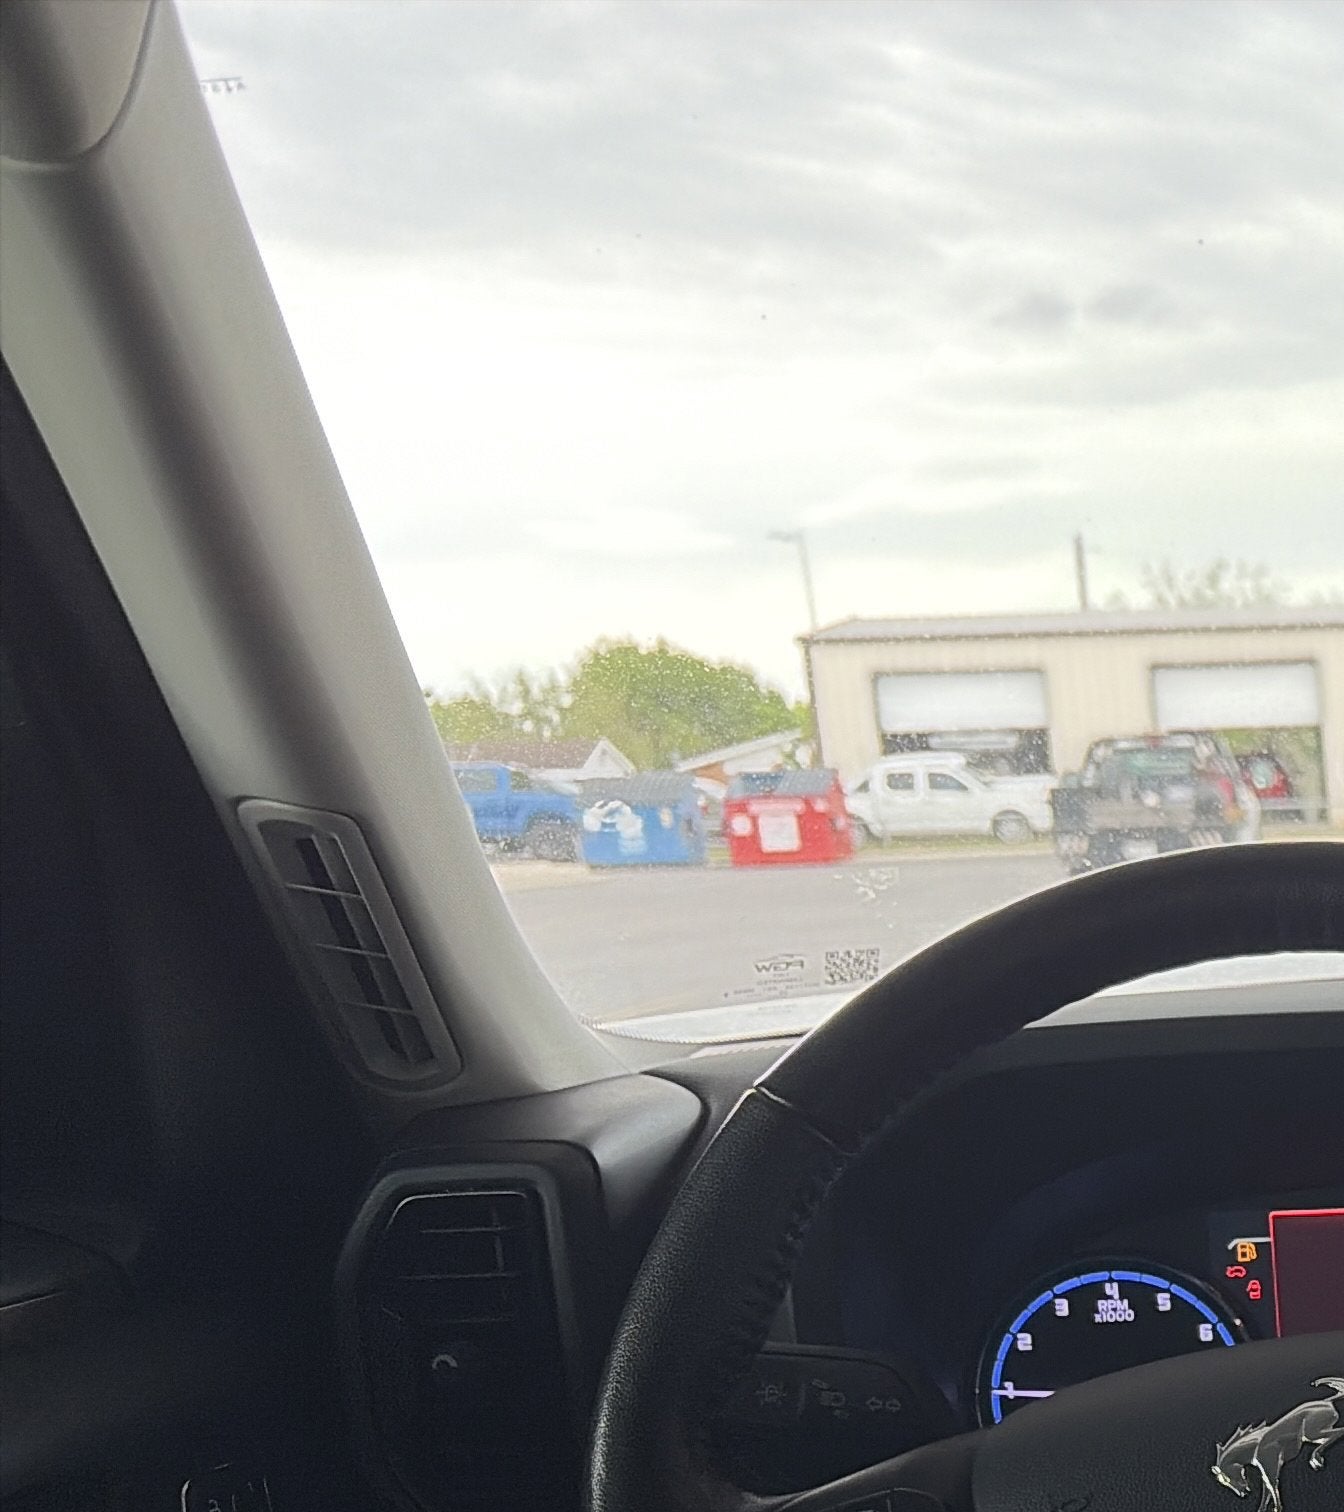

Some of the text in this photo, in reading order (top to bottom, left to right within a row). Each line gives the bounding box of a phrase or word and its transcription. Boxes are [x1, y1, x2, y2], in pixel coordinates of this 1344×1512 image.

[1104, 1282, 1120, 1299] 4
[1054, 1298, 1069, 1317] 3
[1097, 1299, 1129, 1311] RPM
[1156, 1292, 1172, 1311] 5
[1094, 1309, 1135, 1324] x1000
[1016, 1332, 1033, 1351] 2
[1199, 1323, 1214, 1342] 6
